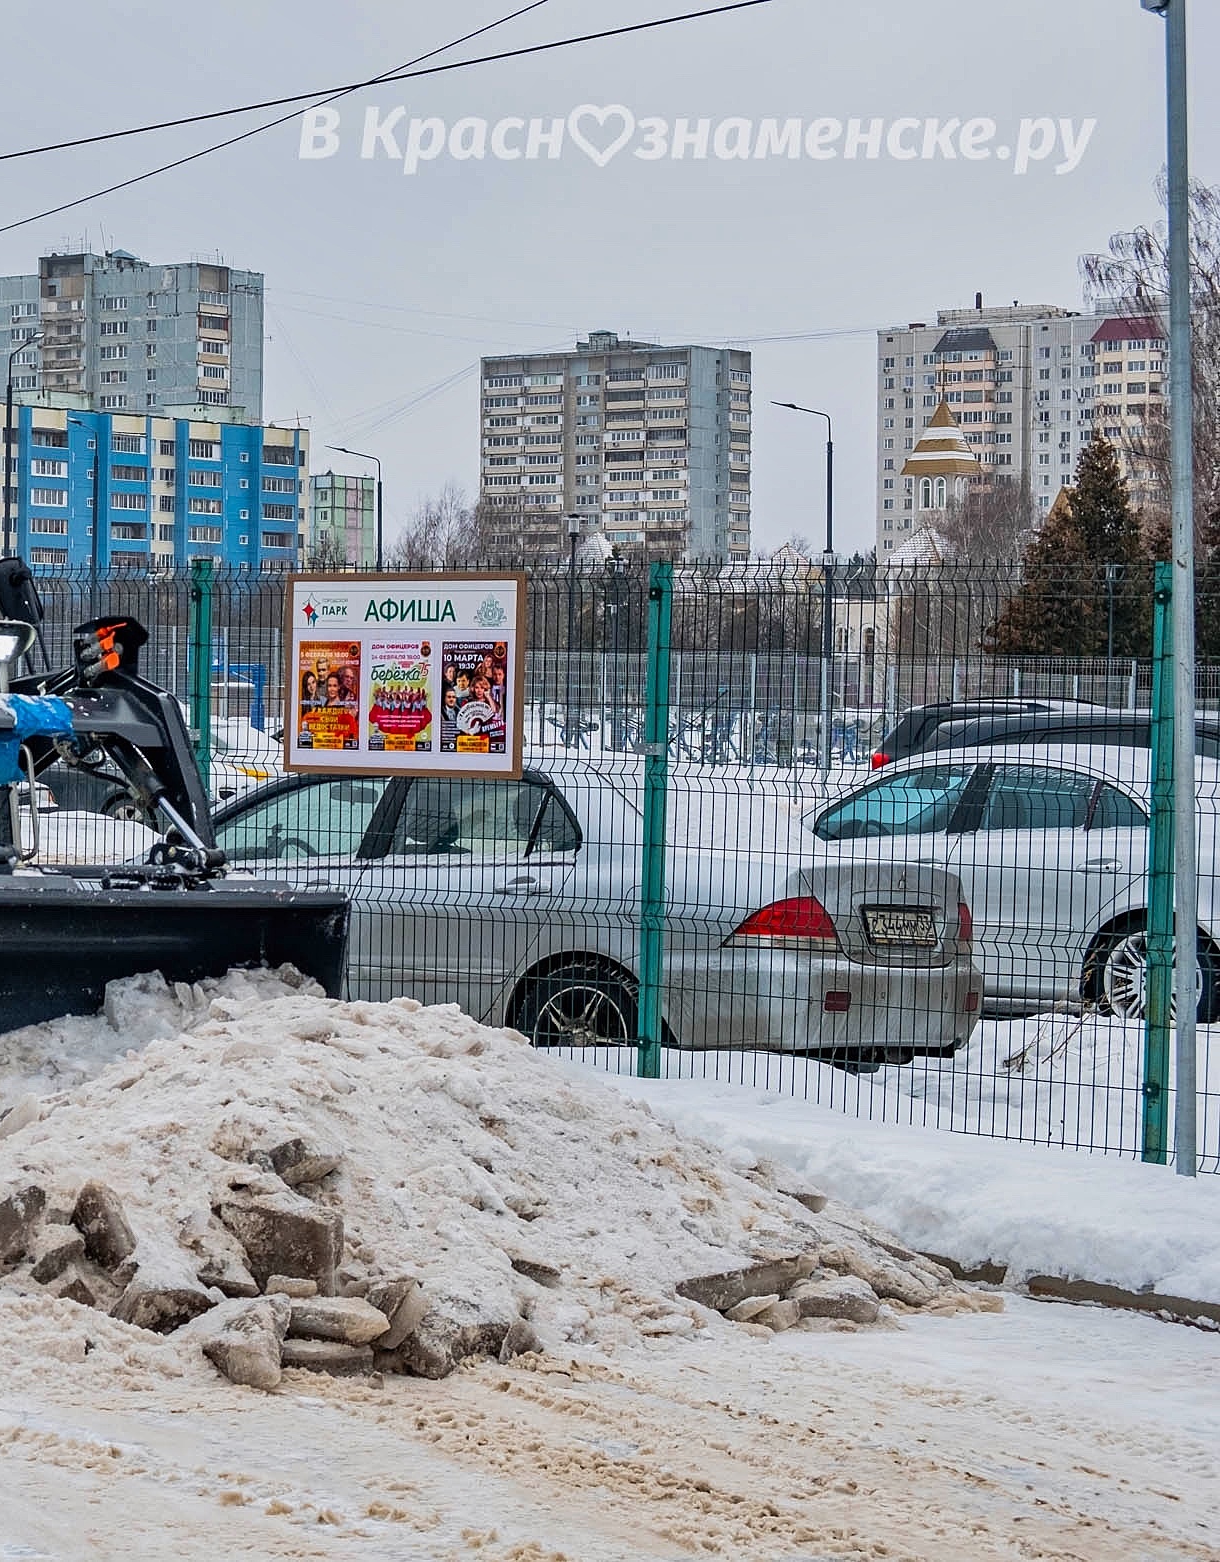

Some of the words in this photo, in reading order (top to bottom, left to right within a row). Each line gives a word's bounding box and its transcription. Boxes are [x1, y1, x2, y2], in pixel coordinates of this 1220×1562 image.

[322, 605, 348, 616] ПАРК
[364, 598, 456, 623] АФИША
[443, 654, 452, 662] 10
[454, 654, 484, 662] МАРТА
